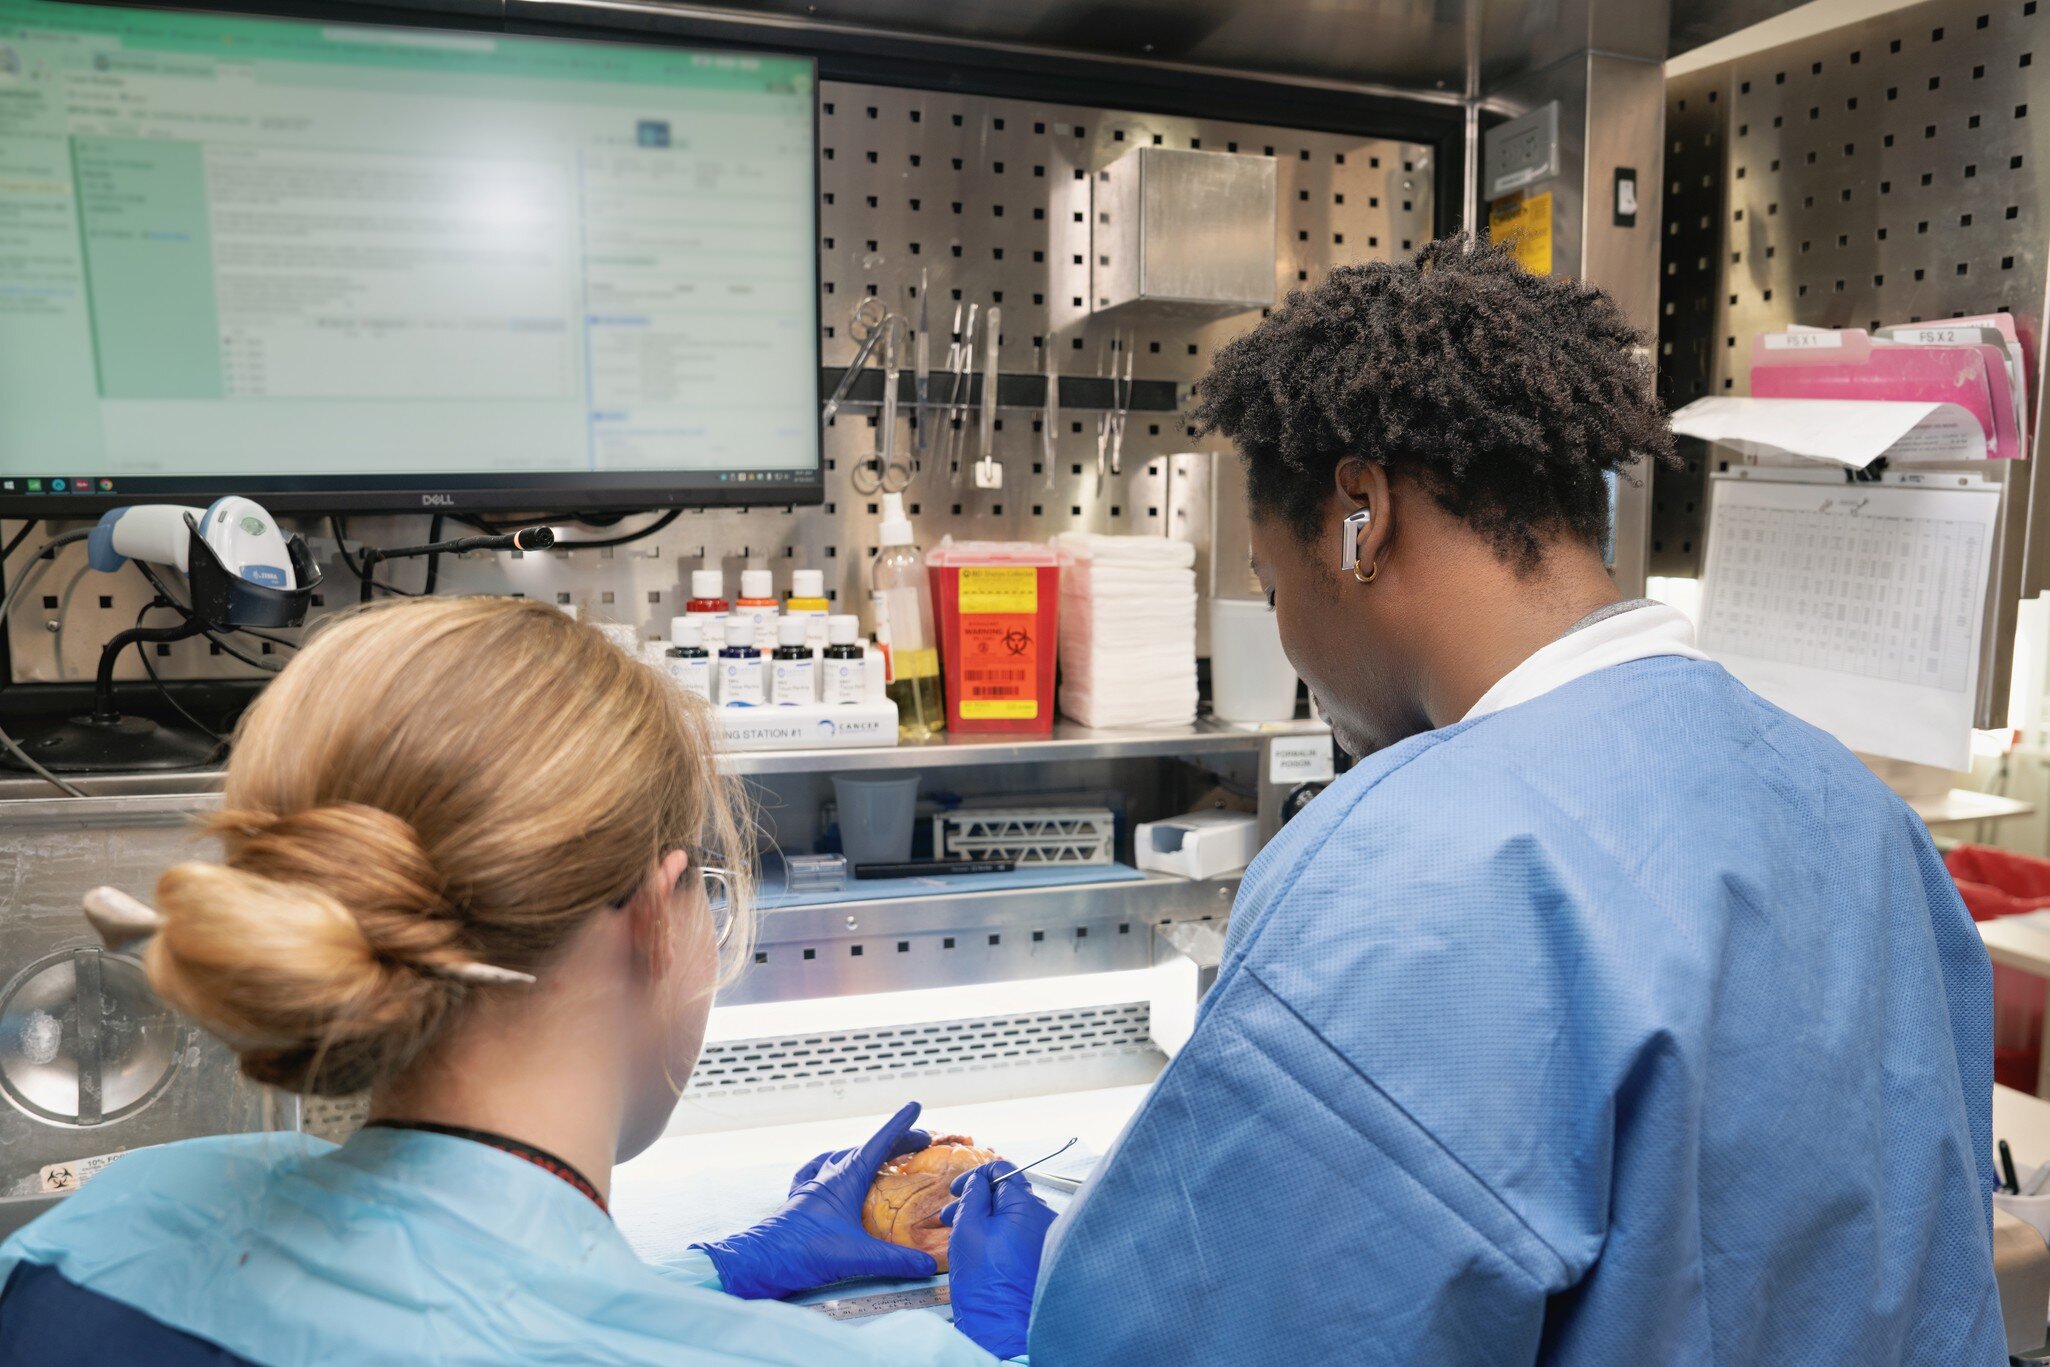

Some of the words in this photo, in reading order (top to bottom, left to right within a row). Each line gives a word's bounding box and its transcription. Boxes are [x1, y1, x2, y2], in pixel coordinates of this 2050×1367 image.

[1787, 335, 1800, 346] FS
[1802, 335, 1809, 345] X
[1920, 331, 1934, 342] FS
[1937, 331, 1945, 342] X
[1948, 331, 1955, 342] 2
[422, 494, 455, 506] DELL
[742, 729, 788, 740] STATION
[791, 728, 802, 738] #1
